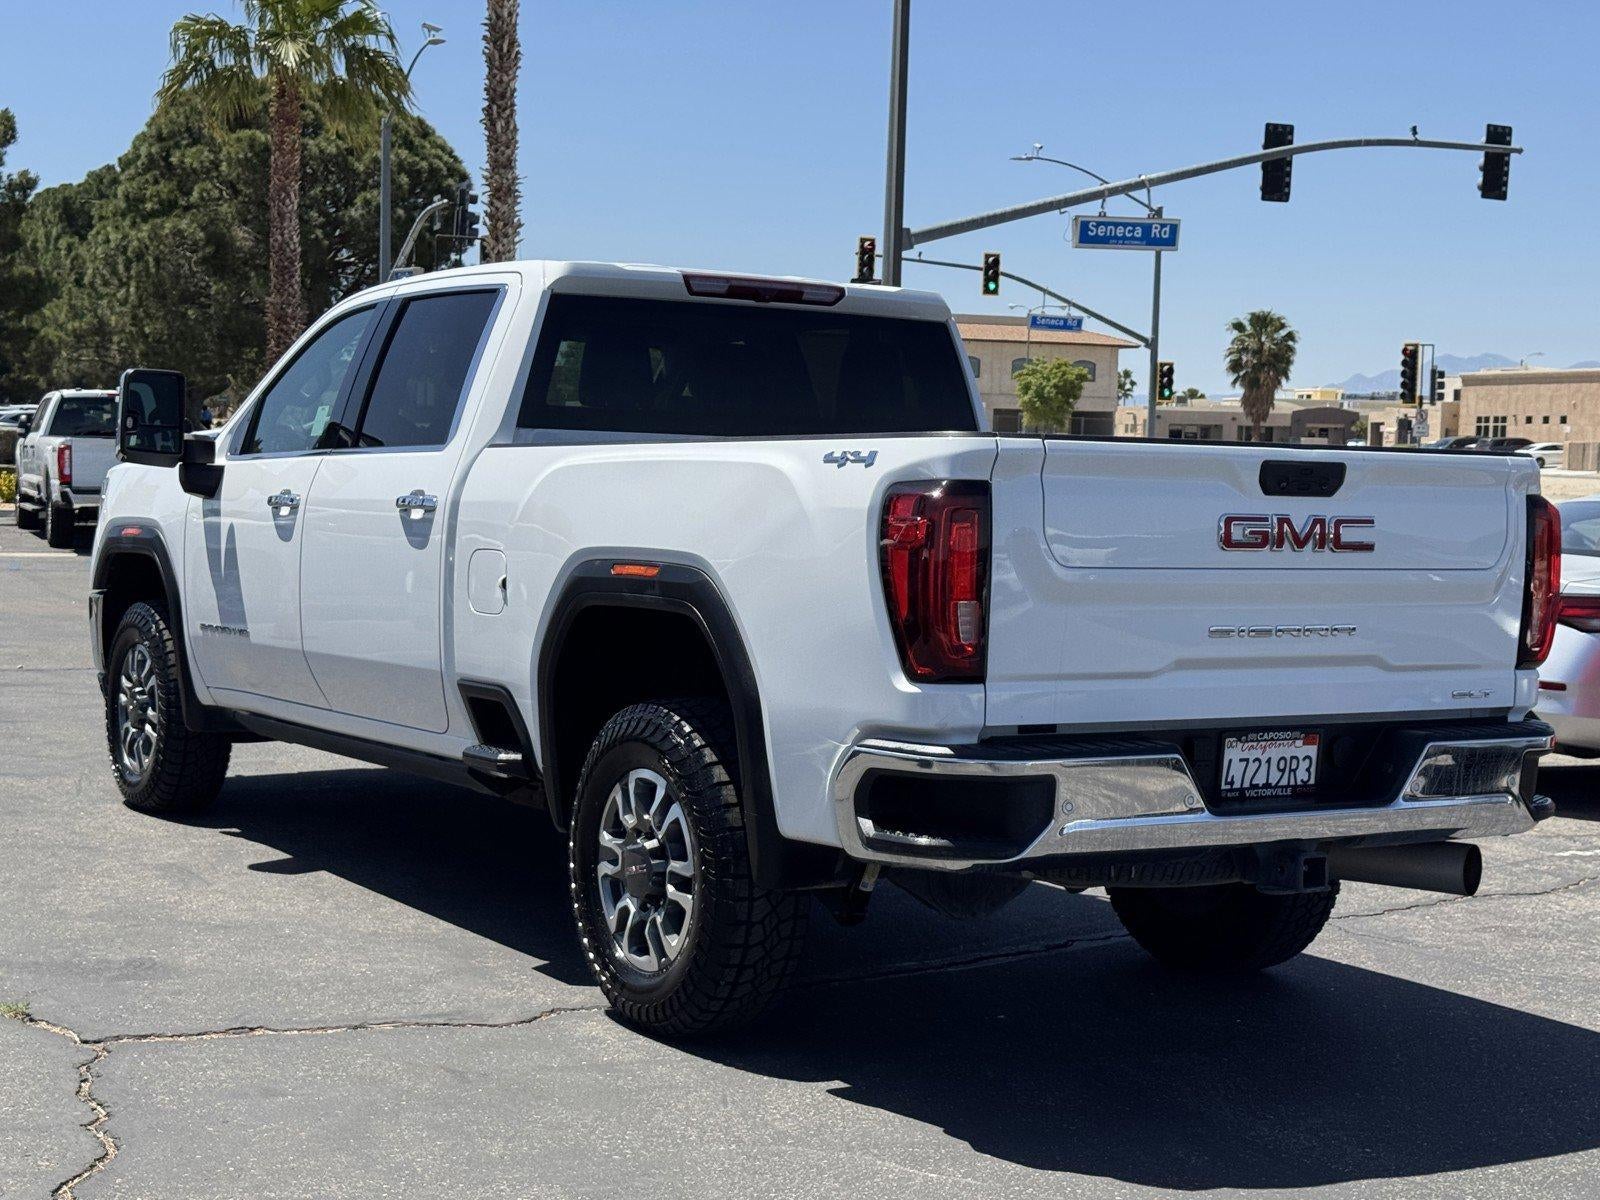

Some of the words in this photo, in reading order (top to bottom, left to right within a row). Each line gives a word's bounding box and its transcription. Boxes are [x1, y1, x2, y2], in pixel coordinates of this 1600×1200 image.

[1088, 221, 1142, 238] Seneca
[1151, 223, 1170, 238] Rd
[1036, 316, 1064, 326] Seneca
[1067, 317, 1077, 327] Rd
[1218, 513, 1375, 552] GMC
[1208, 625, 1357, 639] SIERRA
[1451, 689, 1495, 699] SLT
[1257, 731, 1292, 740] CAPOSIO
[1226, 740, 1238, 749] OCT
[1241, 740, 1303, 755] California
[1223, 754, 1313, 788] 47219R3
[1245, 787, 1292, 797] VICTORVILLE
